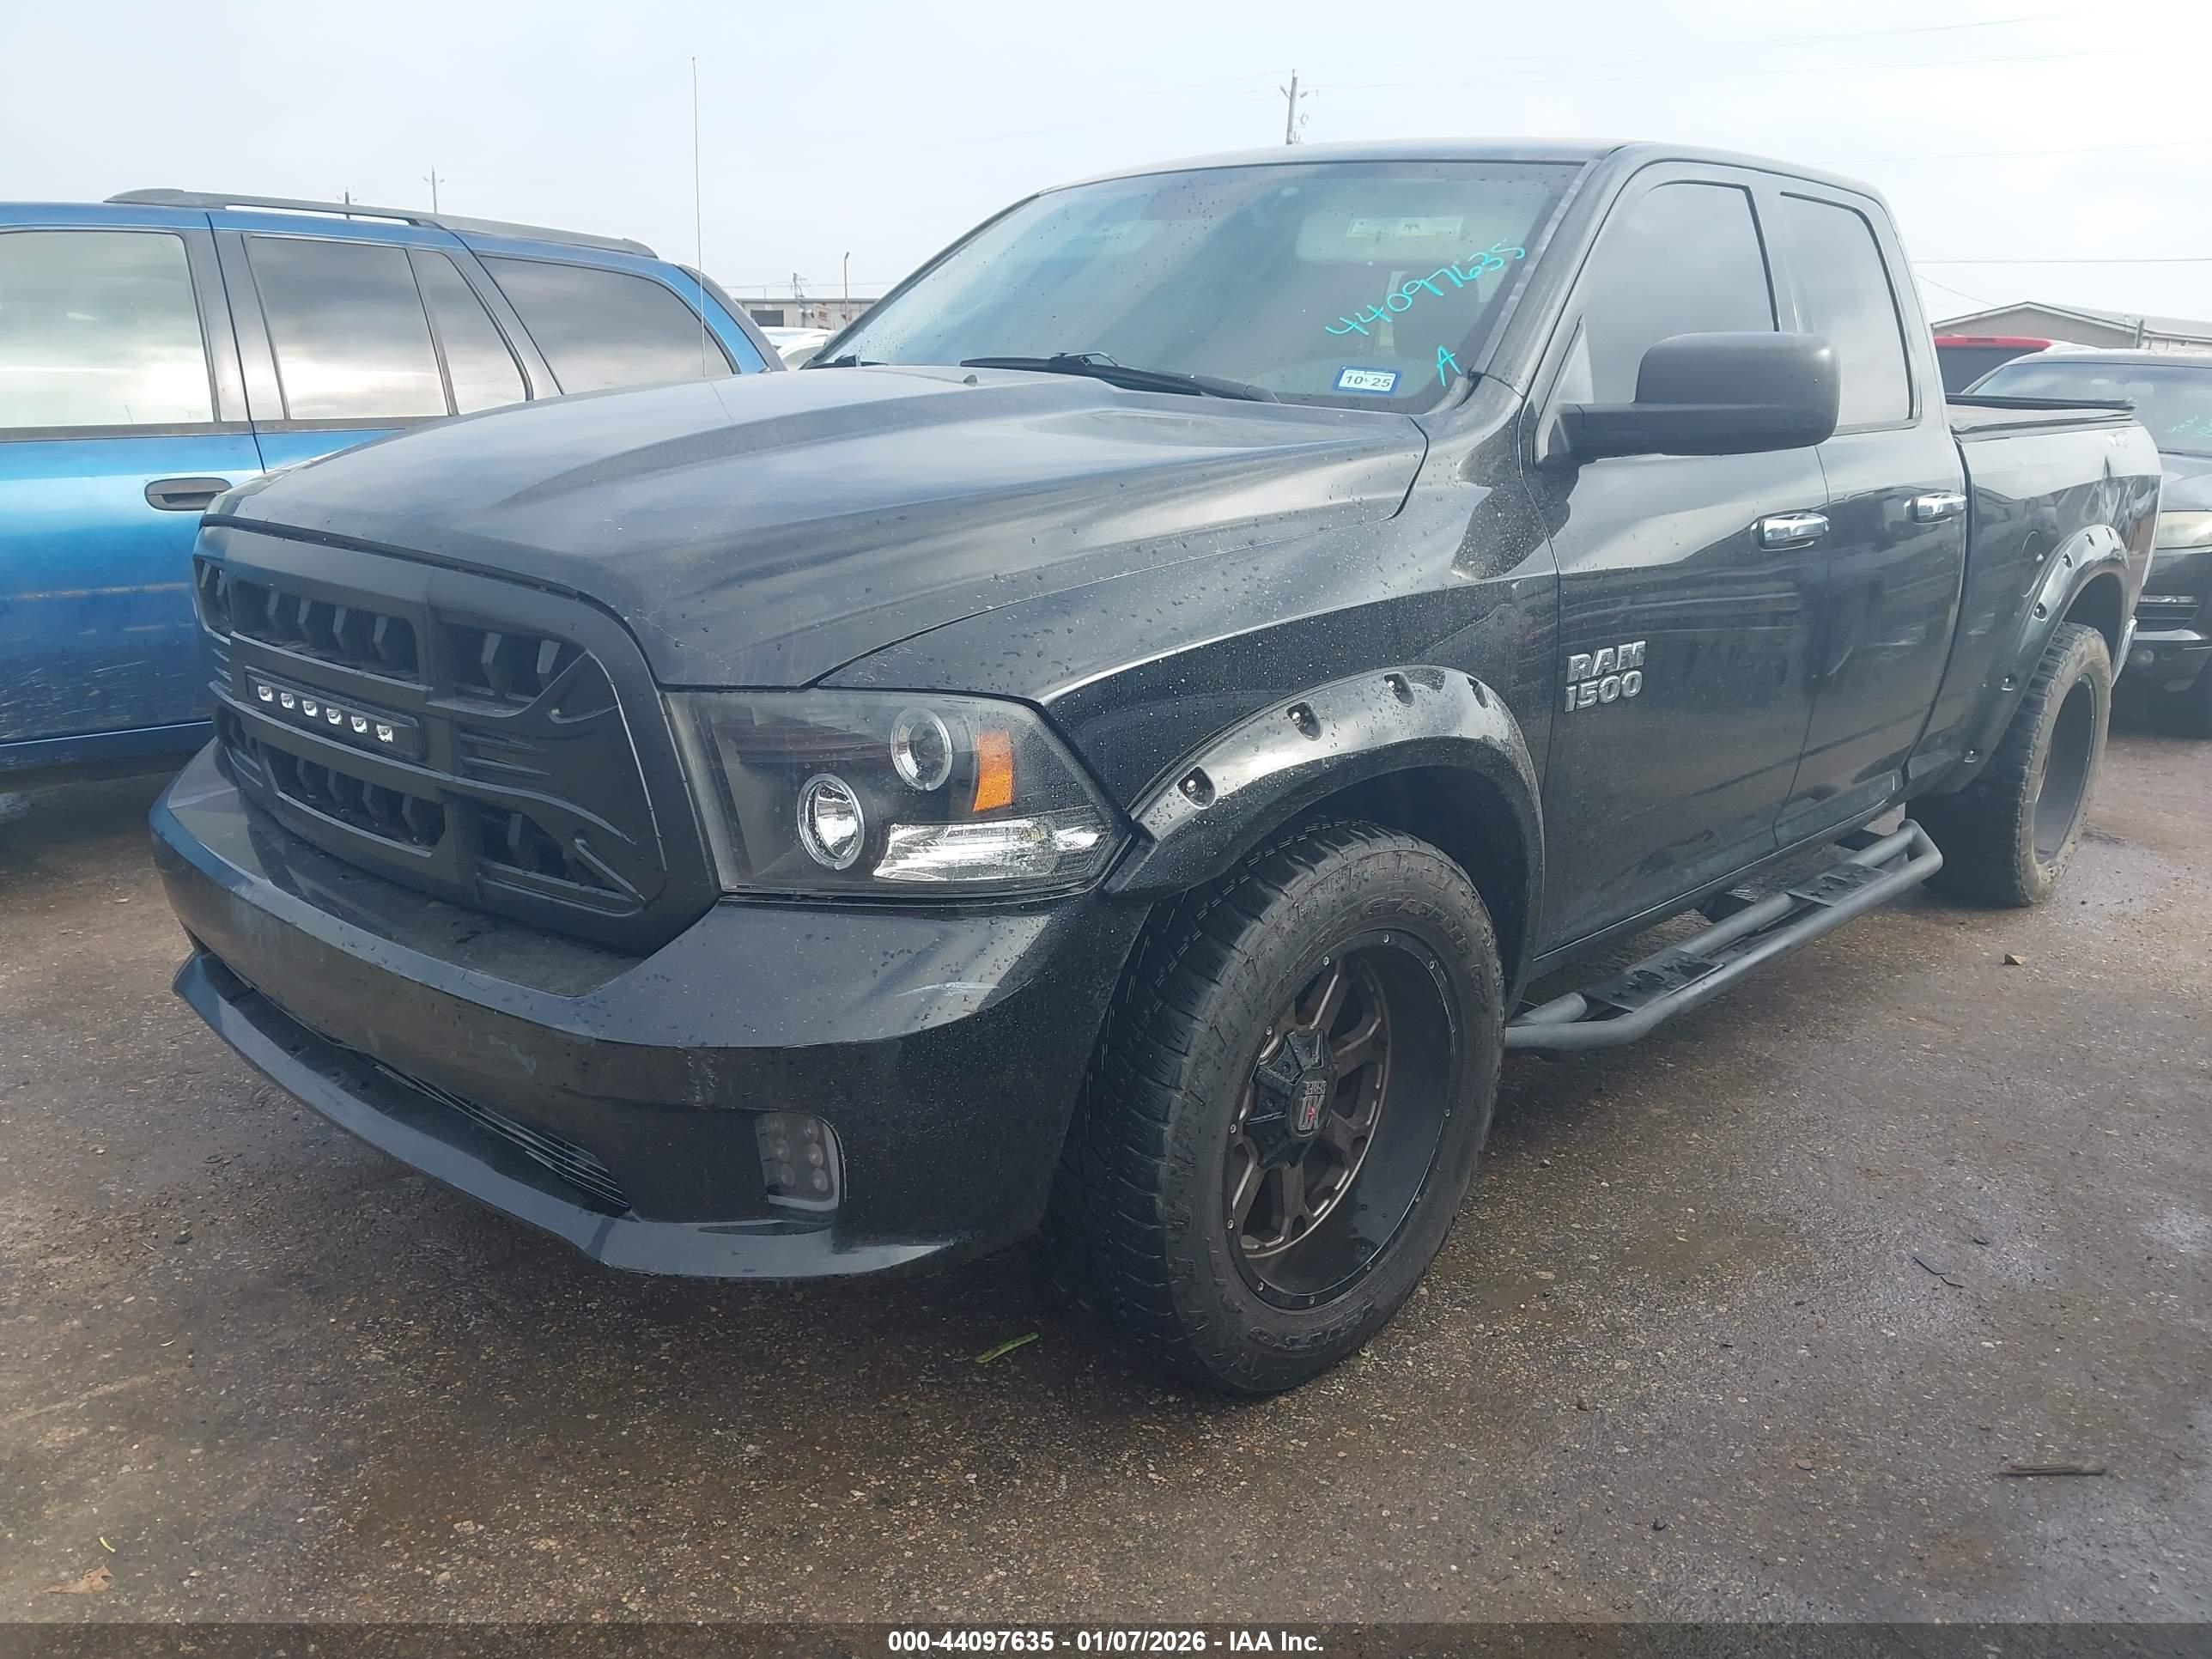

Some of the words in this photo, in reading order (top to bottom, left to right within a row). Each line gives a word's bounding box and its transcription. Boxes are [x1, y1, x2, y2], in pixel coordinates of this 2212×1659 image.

[1324, 238, 1526, 336] 44097635
[1346, 374, 1364, 385] 10
[1370, 378, 1391, 388] 25
[1437, 344, 1462, 386] A
[1566, 640, 1647, 684] RAM
[1565, 670, 1643, 713] 1500
